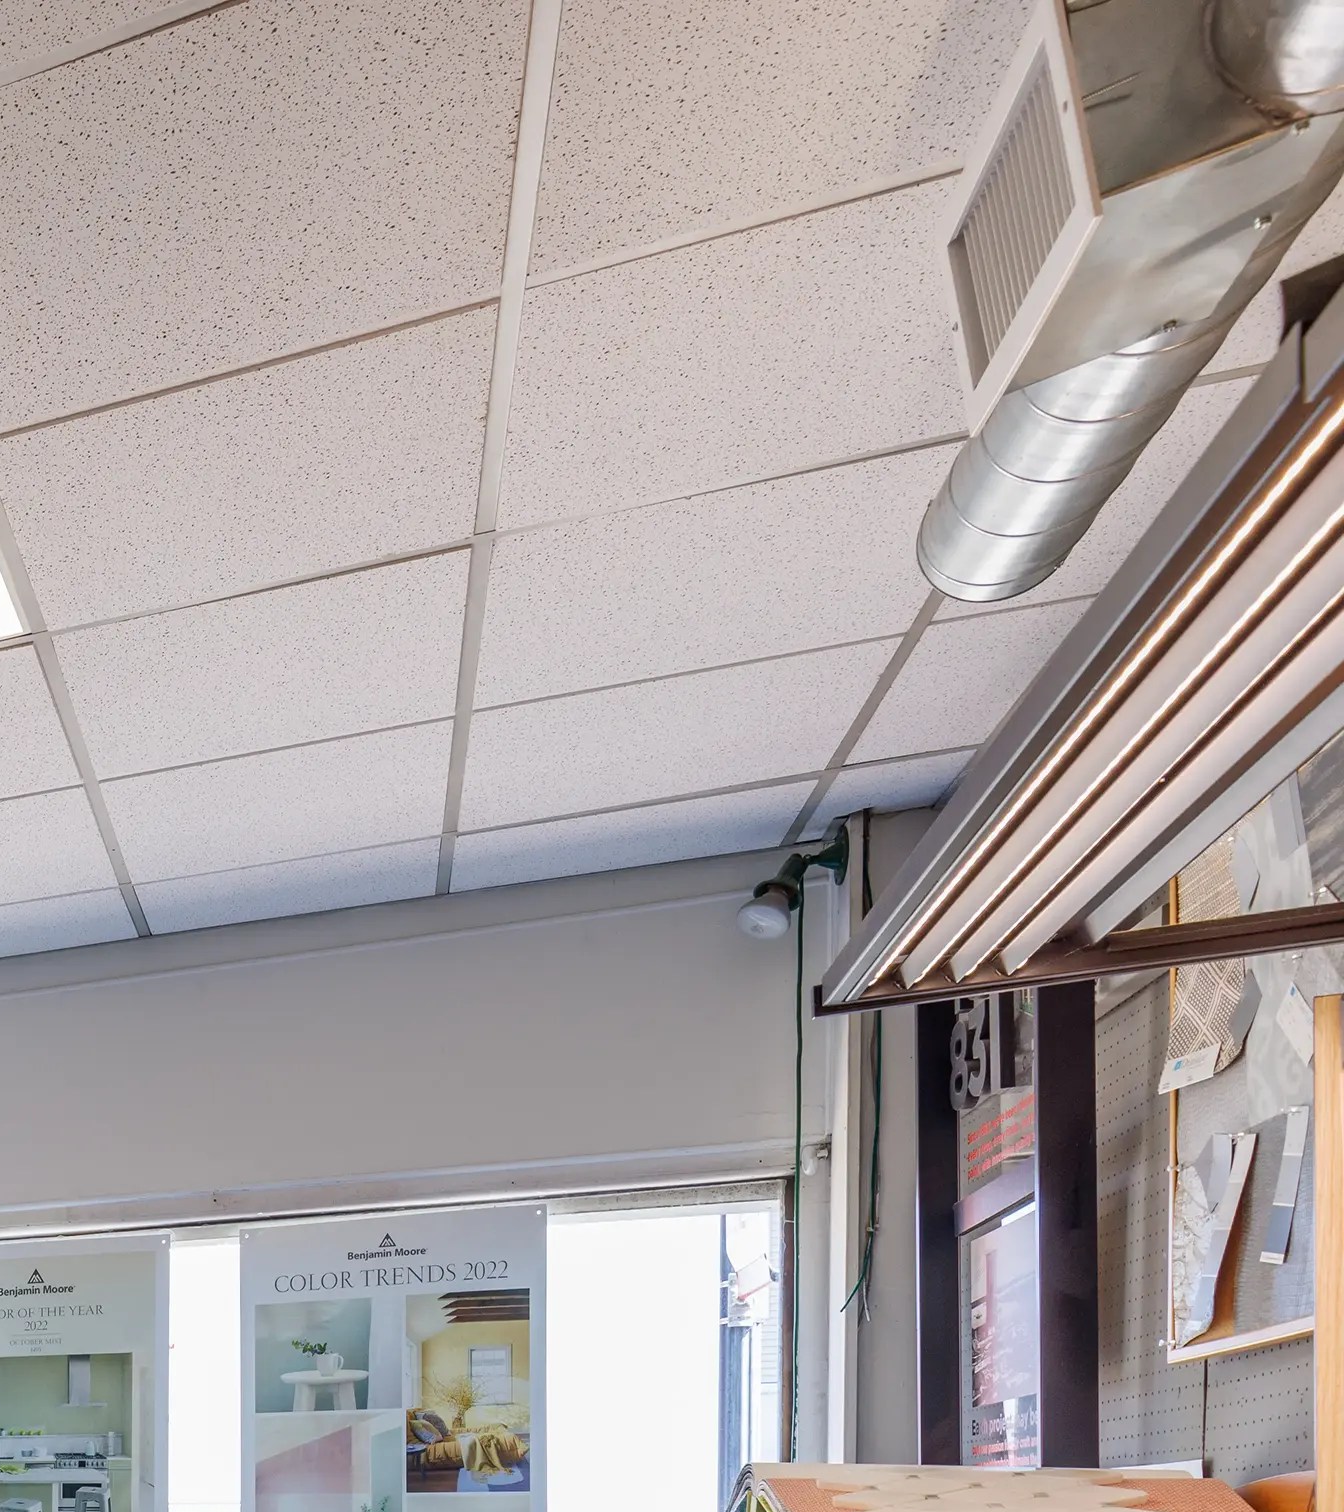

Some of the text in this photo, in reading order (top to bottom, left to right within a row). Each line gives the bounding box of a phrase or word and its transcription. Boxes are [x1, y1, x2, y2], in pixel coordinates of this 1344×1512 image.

[347, 1247, 426, 1260] Benjamin Moore
[275, 1260, 508, 1293] COLOR TRENDS 2022
[43, 1285, 74, 1294] Moore
[17, 1307, 34, 1318] OF
[40, 1307, 65, 1317] THE
[69, 1305, 103, 1316] YEAR
[24, 1320, 48, 1331] 2022
